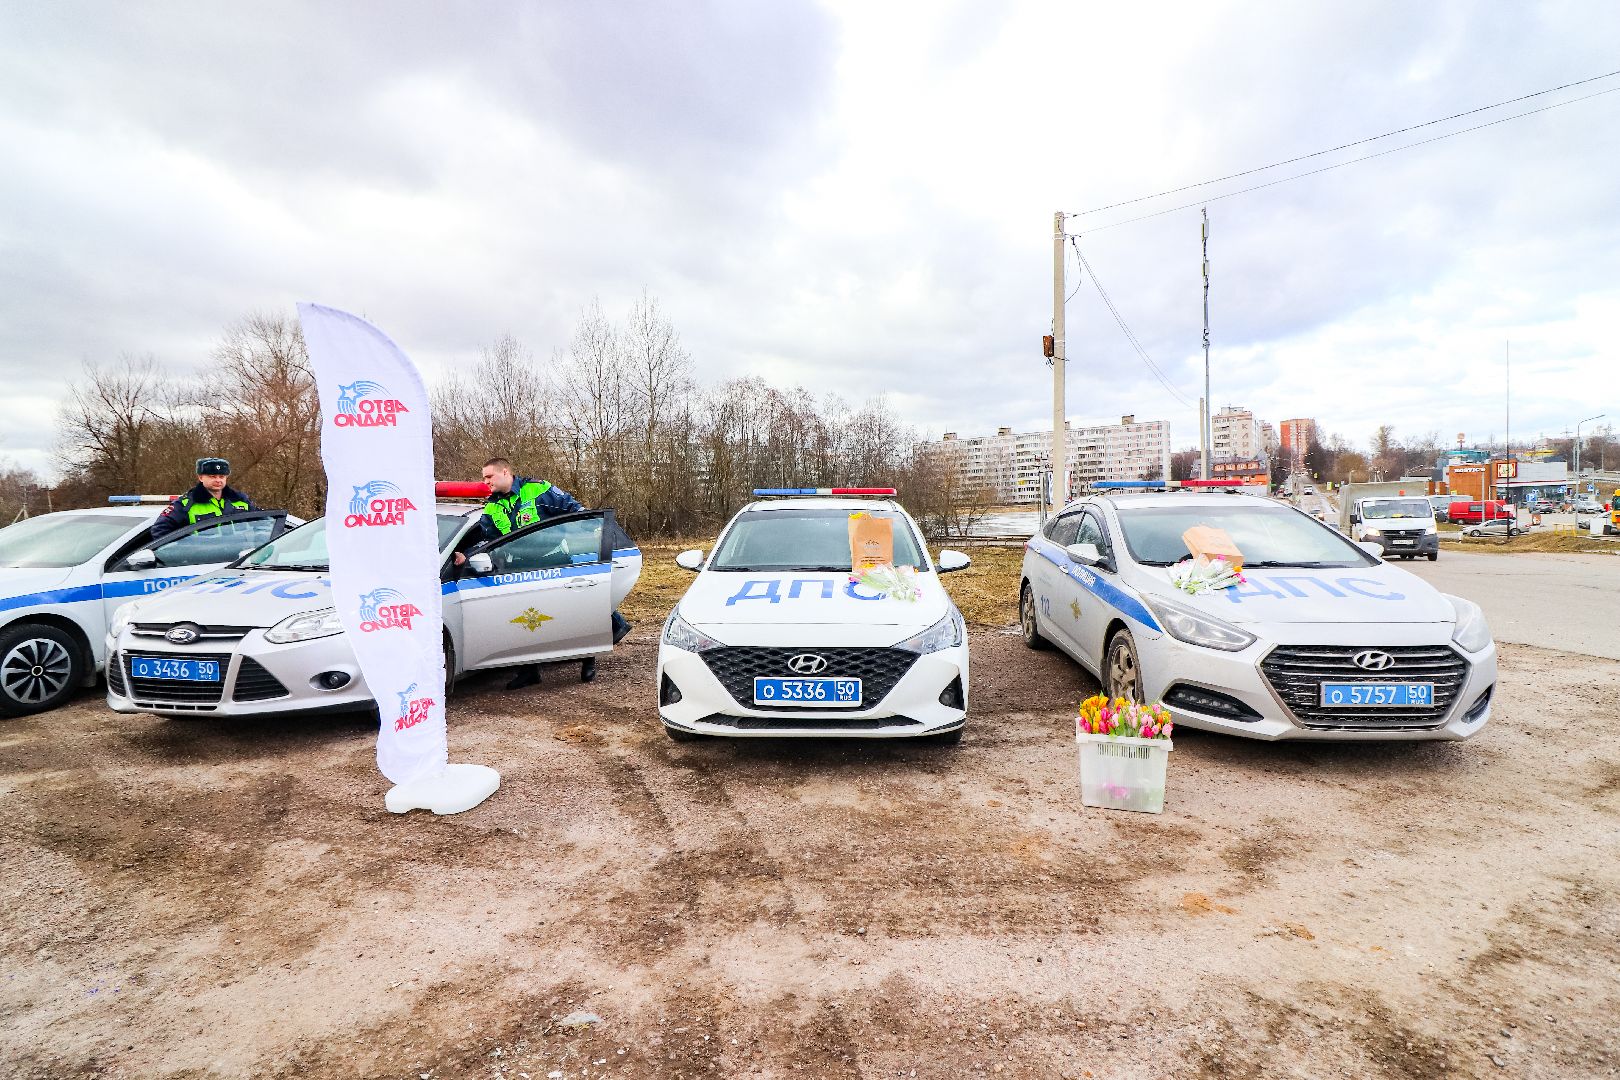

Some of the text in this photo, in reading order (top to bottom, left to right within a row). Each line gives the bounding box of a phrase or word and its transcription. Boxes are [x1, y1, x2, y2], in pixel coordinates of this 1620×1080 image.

[143, 577, 187, 593] ПОЛ
[493, 568, 562, 585] ПОЛИЦИЯ
[1225, 576, 1406, 604] ДПС
[153, 660, 190, 677] 3436
[198, 662, 214, 675] 50
[781, 681, 826, 699] 5336
[837, 682, 855, 695] 50
[1350, 686, 1397, 704] 5757
[1408, 686, 1427, 699] 50
